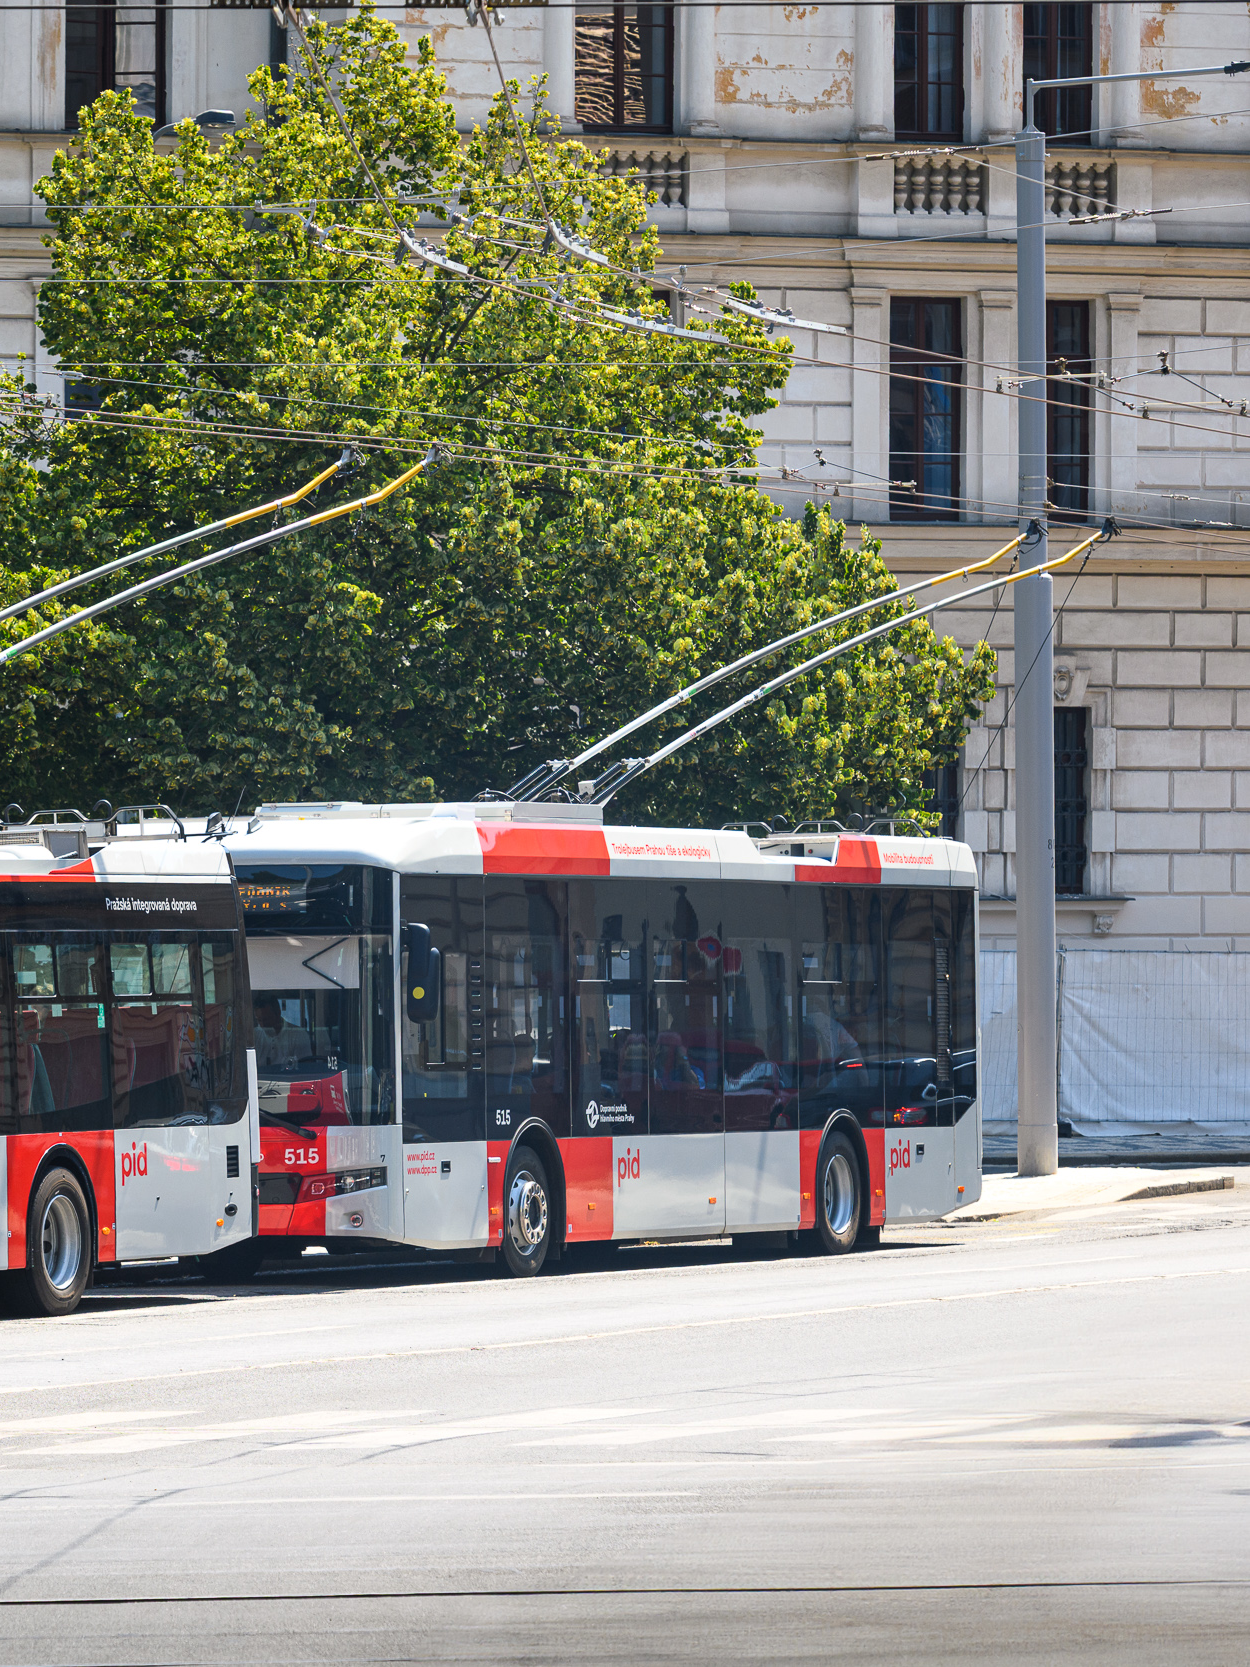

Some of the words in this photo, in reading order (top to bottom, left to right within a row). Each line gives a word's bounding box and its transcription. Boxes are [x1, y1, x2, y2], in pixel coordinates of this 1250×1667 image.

[646, 844, 665, 856] Prahou
[677, 847, 681, 856] a
[682, 845, 711, 860] ekologicky
[105, 897, 131, 911] Pražská
[131, 897, 170, 914] integrovaná
[171, 897, 197, 914] doprava
[495, 1109, 511, 1126] 515
[624, 1113, 635, 1124] Prahy
[121, 1141, 148, 1187] pid
[284, 1148, 320, 1165] 515
[380, 1154, 386, 1163] 7
[406, 1150, 435, 1163] www.pid.cz
[890, 1138, 910, 1176] pid
[407, 1164, 438, 1176] www.dpp.cz
[617, 1147, 640, 1188] pid
